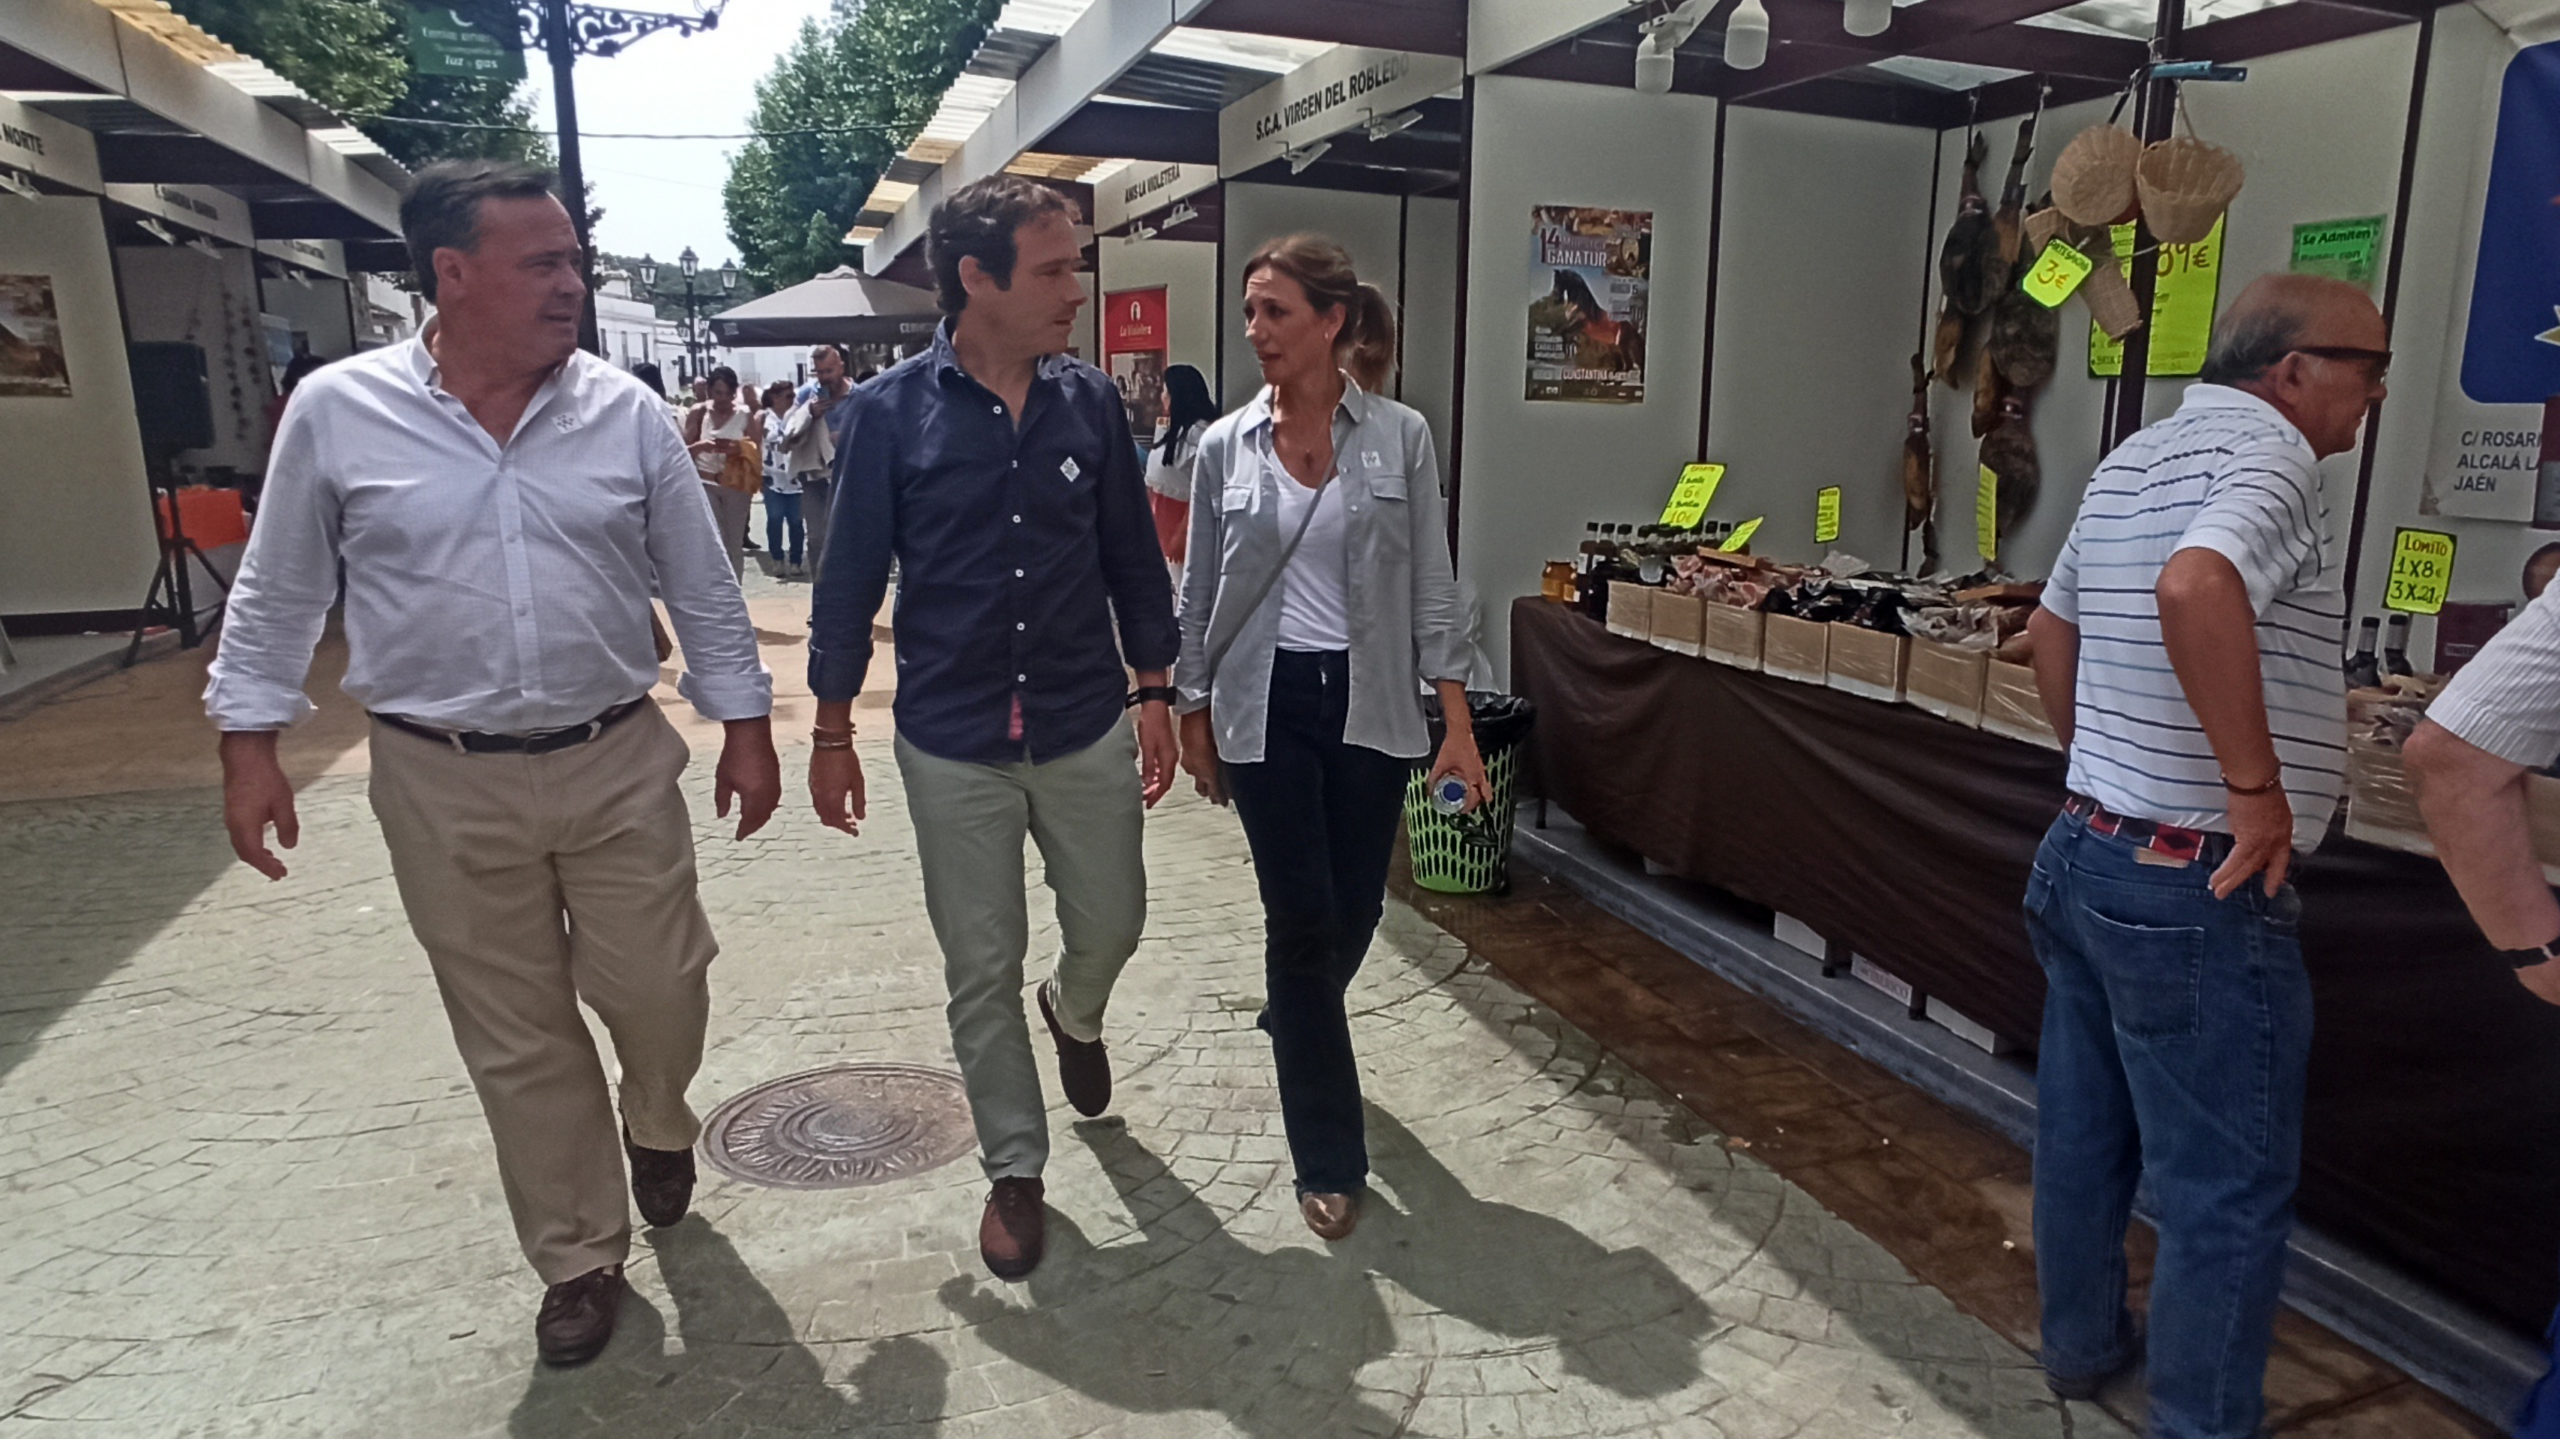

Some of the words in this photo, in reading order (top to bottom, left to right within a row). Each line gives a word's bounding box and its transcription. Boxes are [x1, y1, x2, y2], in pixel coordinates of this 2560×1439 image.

[475, 59, 498, 70] gas
[1256, 112, 1282, 140] S.C.A.
[1284, 90, 1323, 129] VIRGEN
[1325, 80, 1346, 110] DEL
[1349, 52, 1411, 99] ROBLEDO
[2, 122, 45, 156] NORTE
[2318, 228, 2371, 244] Admiten
[2036, 259, 2070, 289] 3€
[2461, 431, 2479, 447] C/
[2457, 451, 2522, 471] ALCALÁ
[2454, 473, 2497, 492] JAÉN
[2404, 533, 2449, 557] LOMITO
